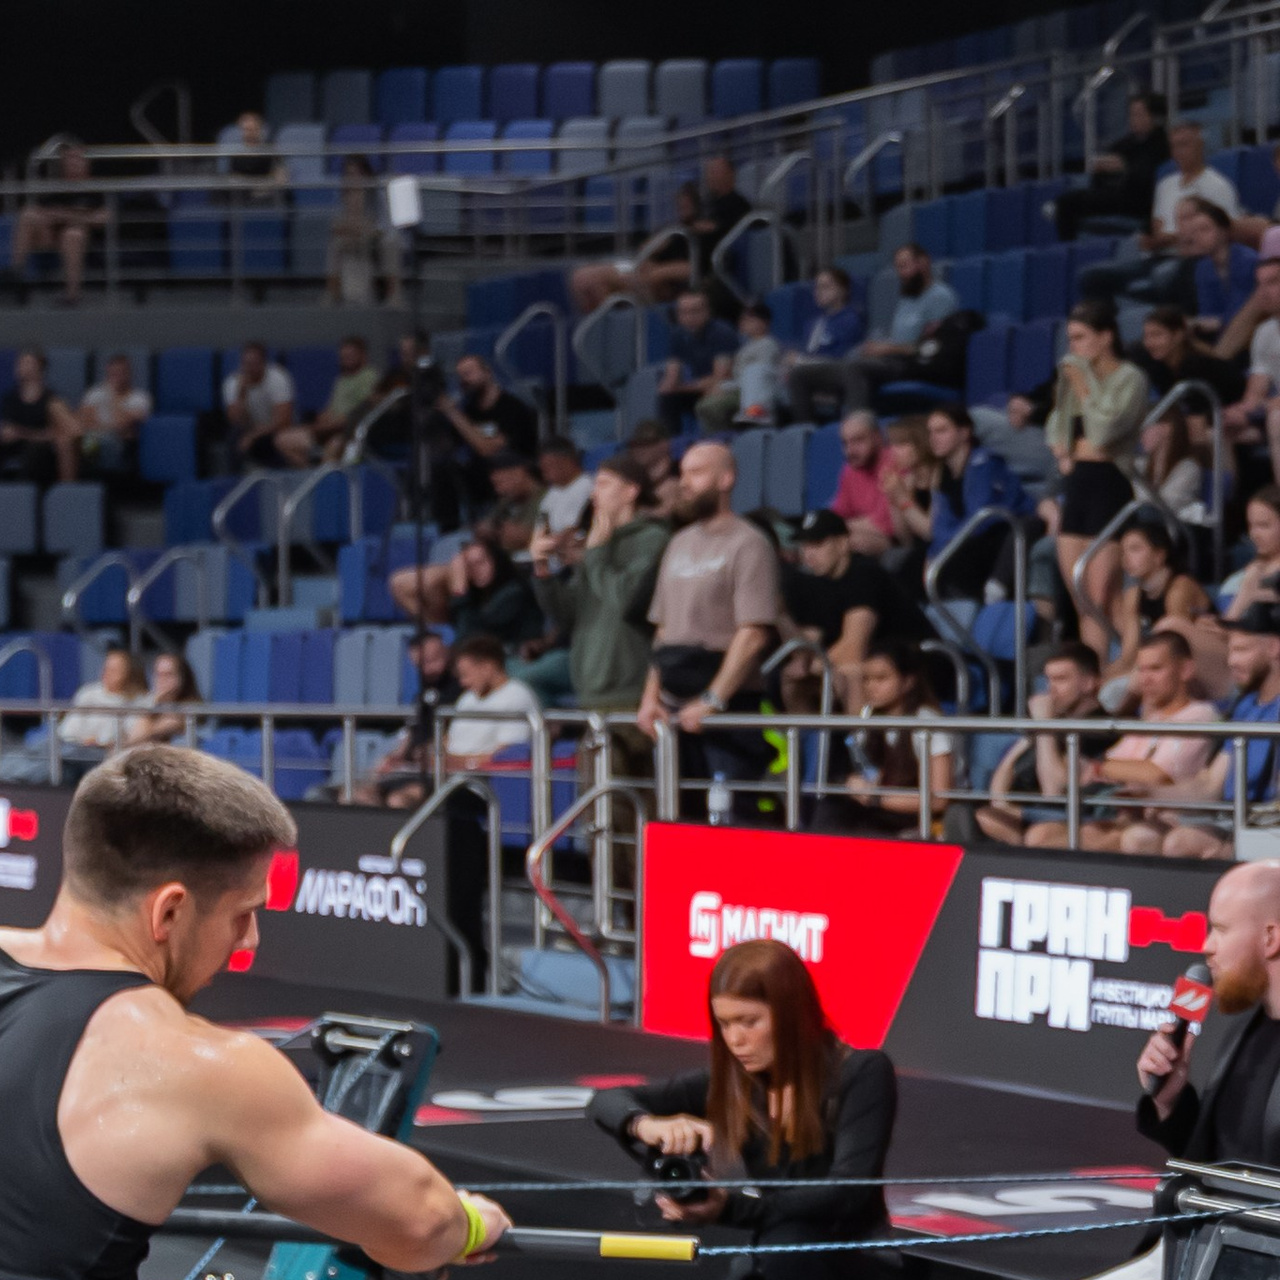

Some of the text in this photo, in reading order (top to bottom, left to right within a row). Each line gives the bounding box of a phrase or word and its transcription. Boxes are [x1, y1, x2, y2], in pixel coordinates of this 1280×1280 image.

[722, 905, 828, 963] МАГНИТ
[980, 877, 1131, 962] ГРАН
[976, 949, 1093, 1031] ПРИ
